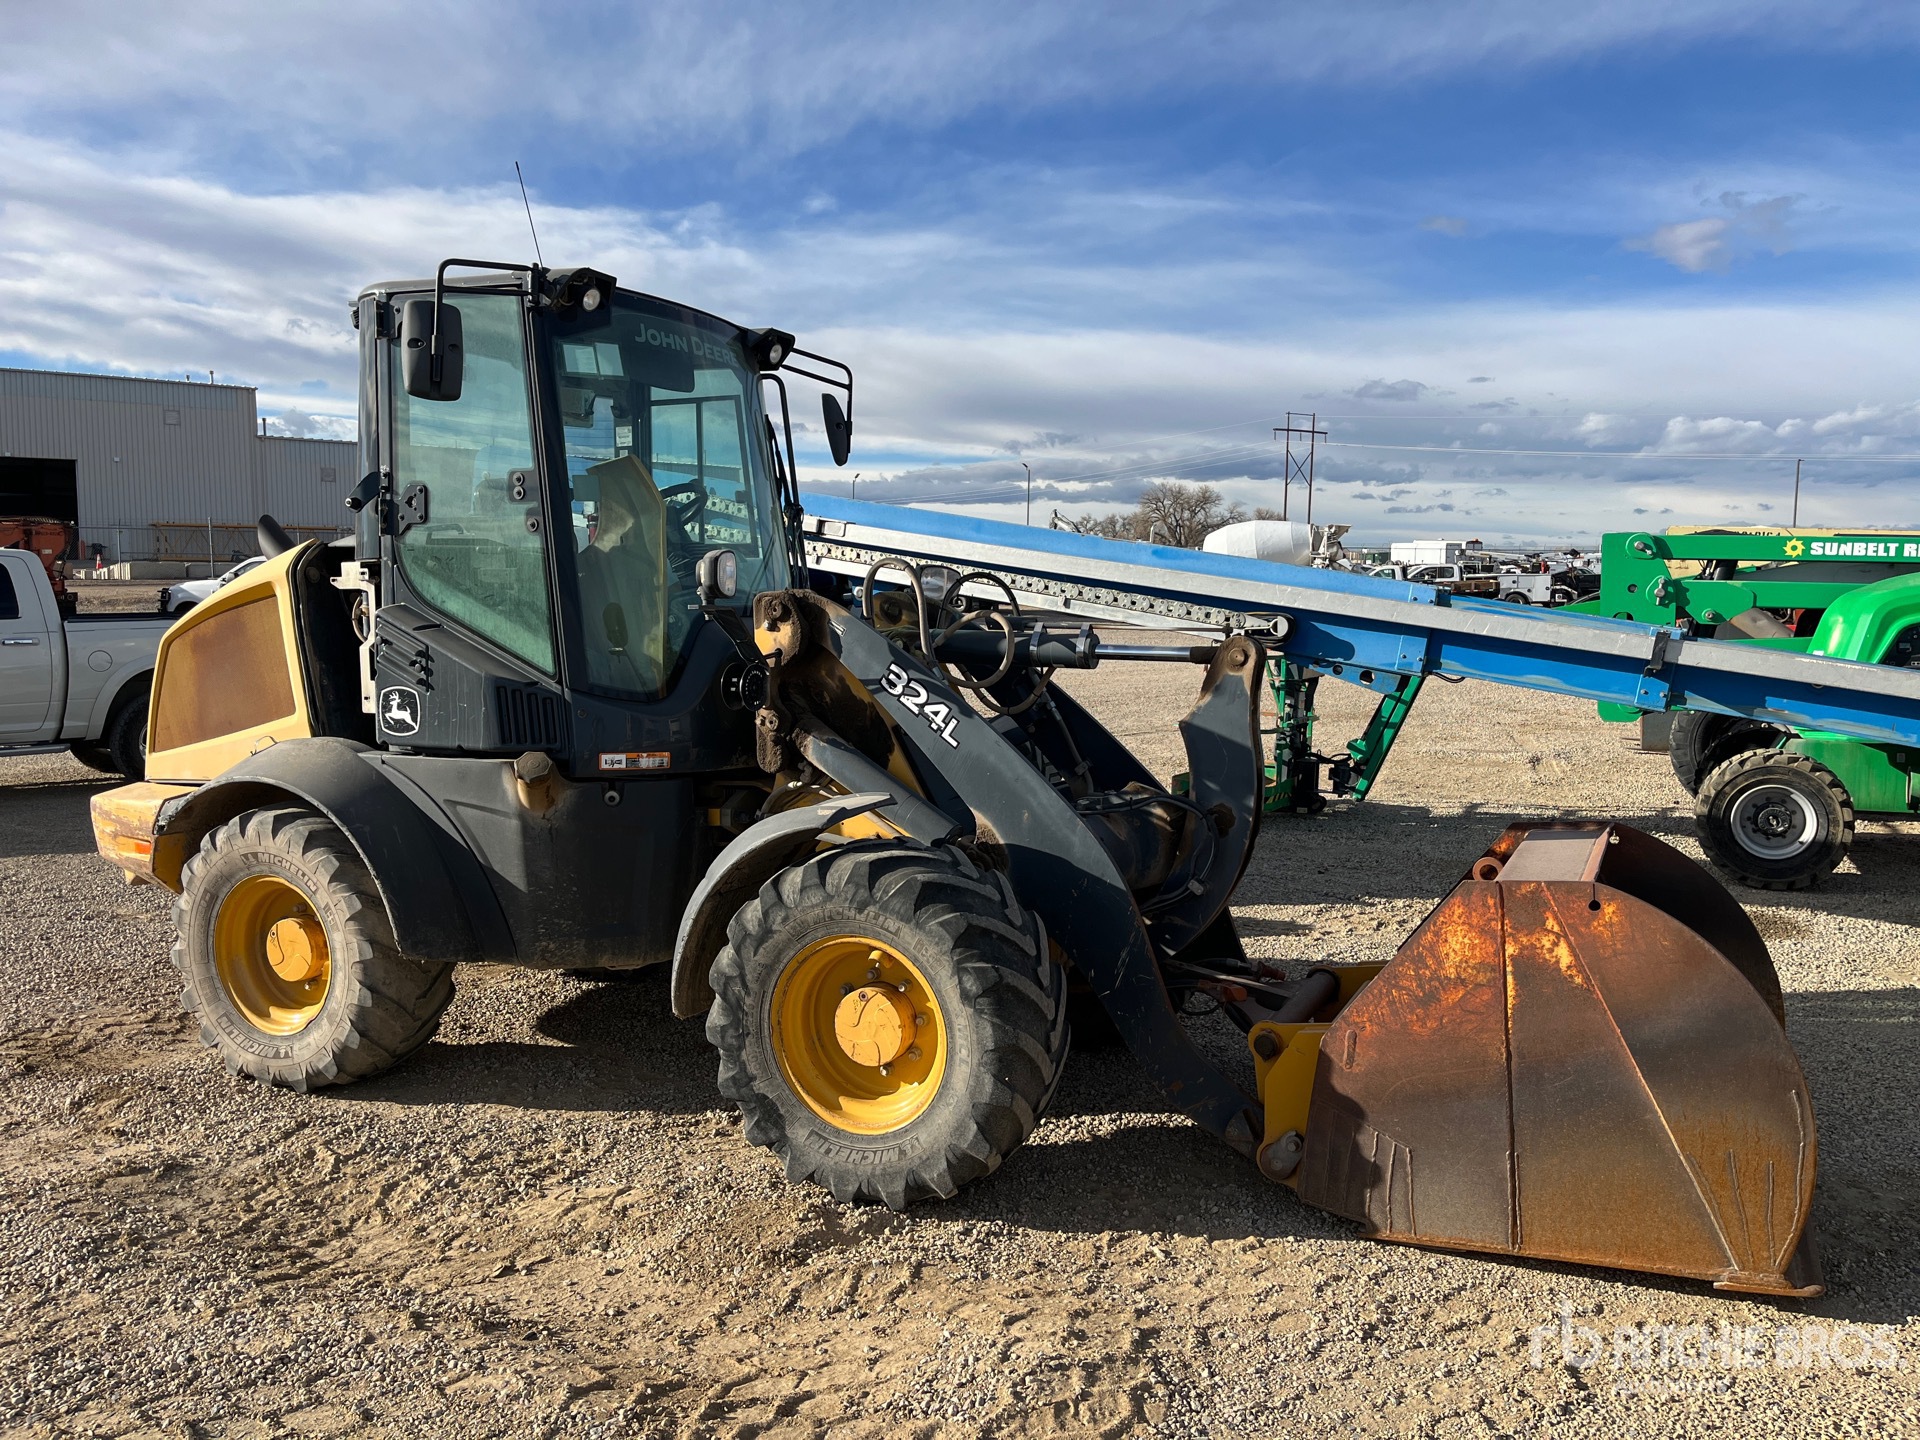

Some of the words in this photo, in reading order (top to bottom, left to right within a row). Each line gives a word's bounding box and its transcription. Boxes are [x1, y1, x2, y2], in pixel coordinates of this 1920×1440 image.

[635, 323, 689, 353] JOHN
[691, 336, 739, 368] DEERE
[1810, 541, 1899, 557] SUNBELT
[1903, 543, 1920, 557] R
[880, 662, 960, 749] 324L
[257, 853, 318, 892] MICHELIN
[217, 1016, 277, 1058] MICHELIN
[805, 1132, 899, 1164] MICHELIN
